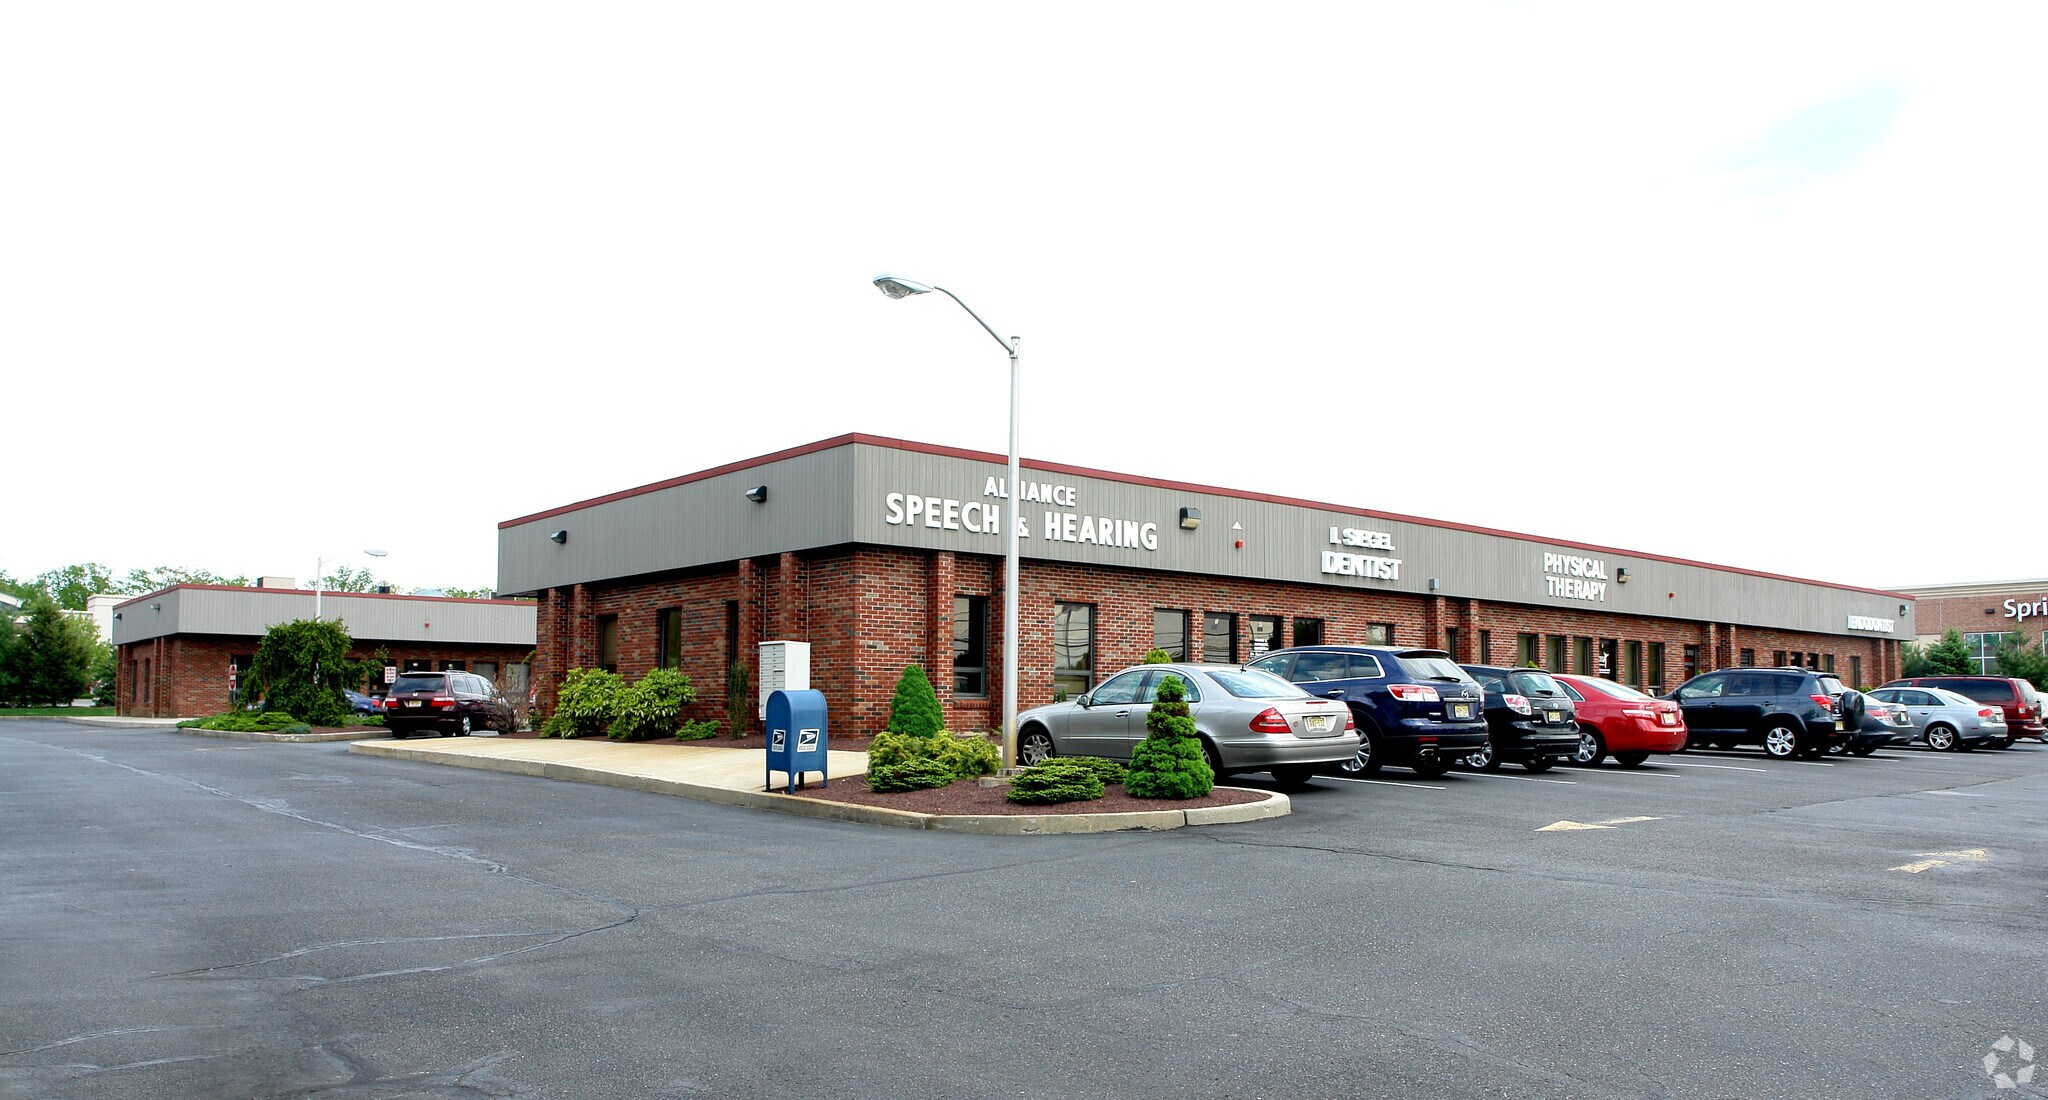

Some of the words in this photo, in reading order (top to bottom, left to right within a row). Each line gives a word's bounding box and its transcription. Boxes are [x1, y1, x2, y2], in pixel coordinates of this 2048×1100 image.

[984, 476, 1076, 507] ALIANCE
[885, 492, 1000, 534] SPEECH
[1044, 511, 1158, 551] HEARING
[1342, 527, 1396, 551] SIEGEL
[1321, 550, 1403, 580] DENTIST
[1543, 552, 1608, 580] PHYSICAL
[1546, 575, 1607, 602] THERAPY
[2003, 596, 2048, 623] Spri
